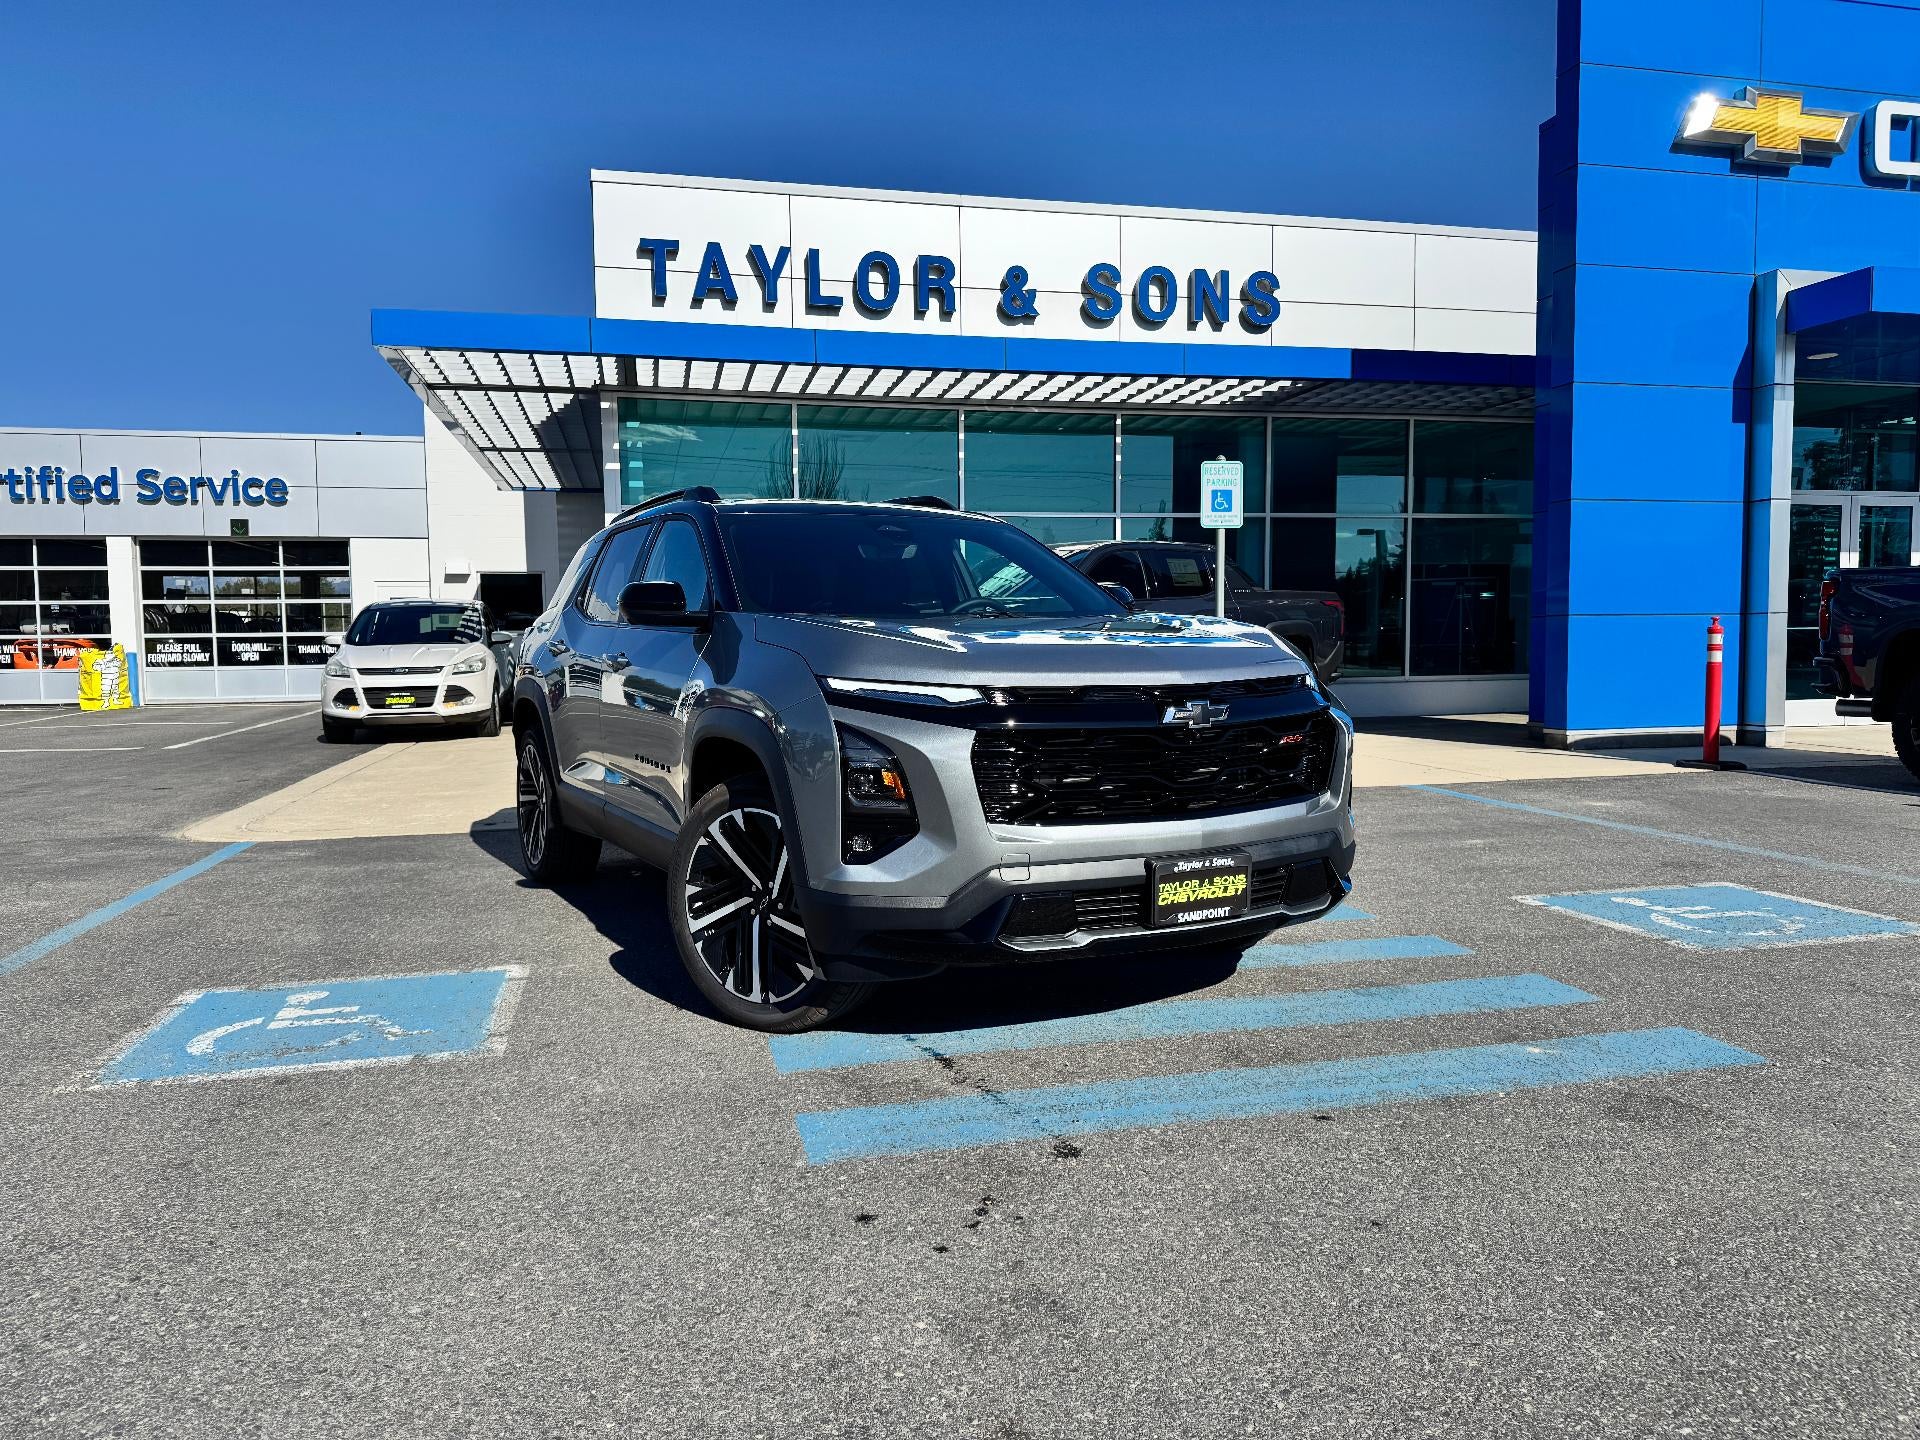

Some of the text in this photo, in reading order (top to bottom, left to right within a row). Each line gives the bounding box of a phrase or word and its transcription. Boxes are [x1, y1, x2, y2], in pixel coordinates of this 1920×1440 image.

[638, 237, 1281, 327] TAYLOR & SONS
[1205, 467, 1239, 475] RESERVED
[136, 468, 289, 503] Service
[1206, 478, 1238, 487] PARKING
[53, 647, 77, 657] THANK
[156, 643, 201, 652] PLEASE PULL
[231, 643, 269, 652] DOOR WILL
[298, 645, 320, 654] THANK
[147, 652, 210, 663] FORWARD SLOWLY
[241, 652, 260, 661] OPEN
[1177, 861, 1203, 872] Taylor
[1159, 880, 1200, 893] TAYLOR
[1213, 874, 1246, 886] SONS
[1157, 884, 1247, 906] CHEVROLET
[1177, 906, 1231, 923] SANDPOINT
